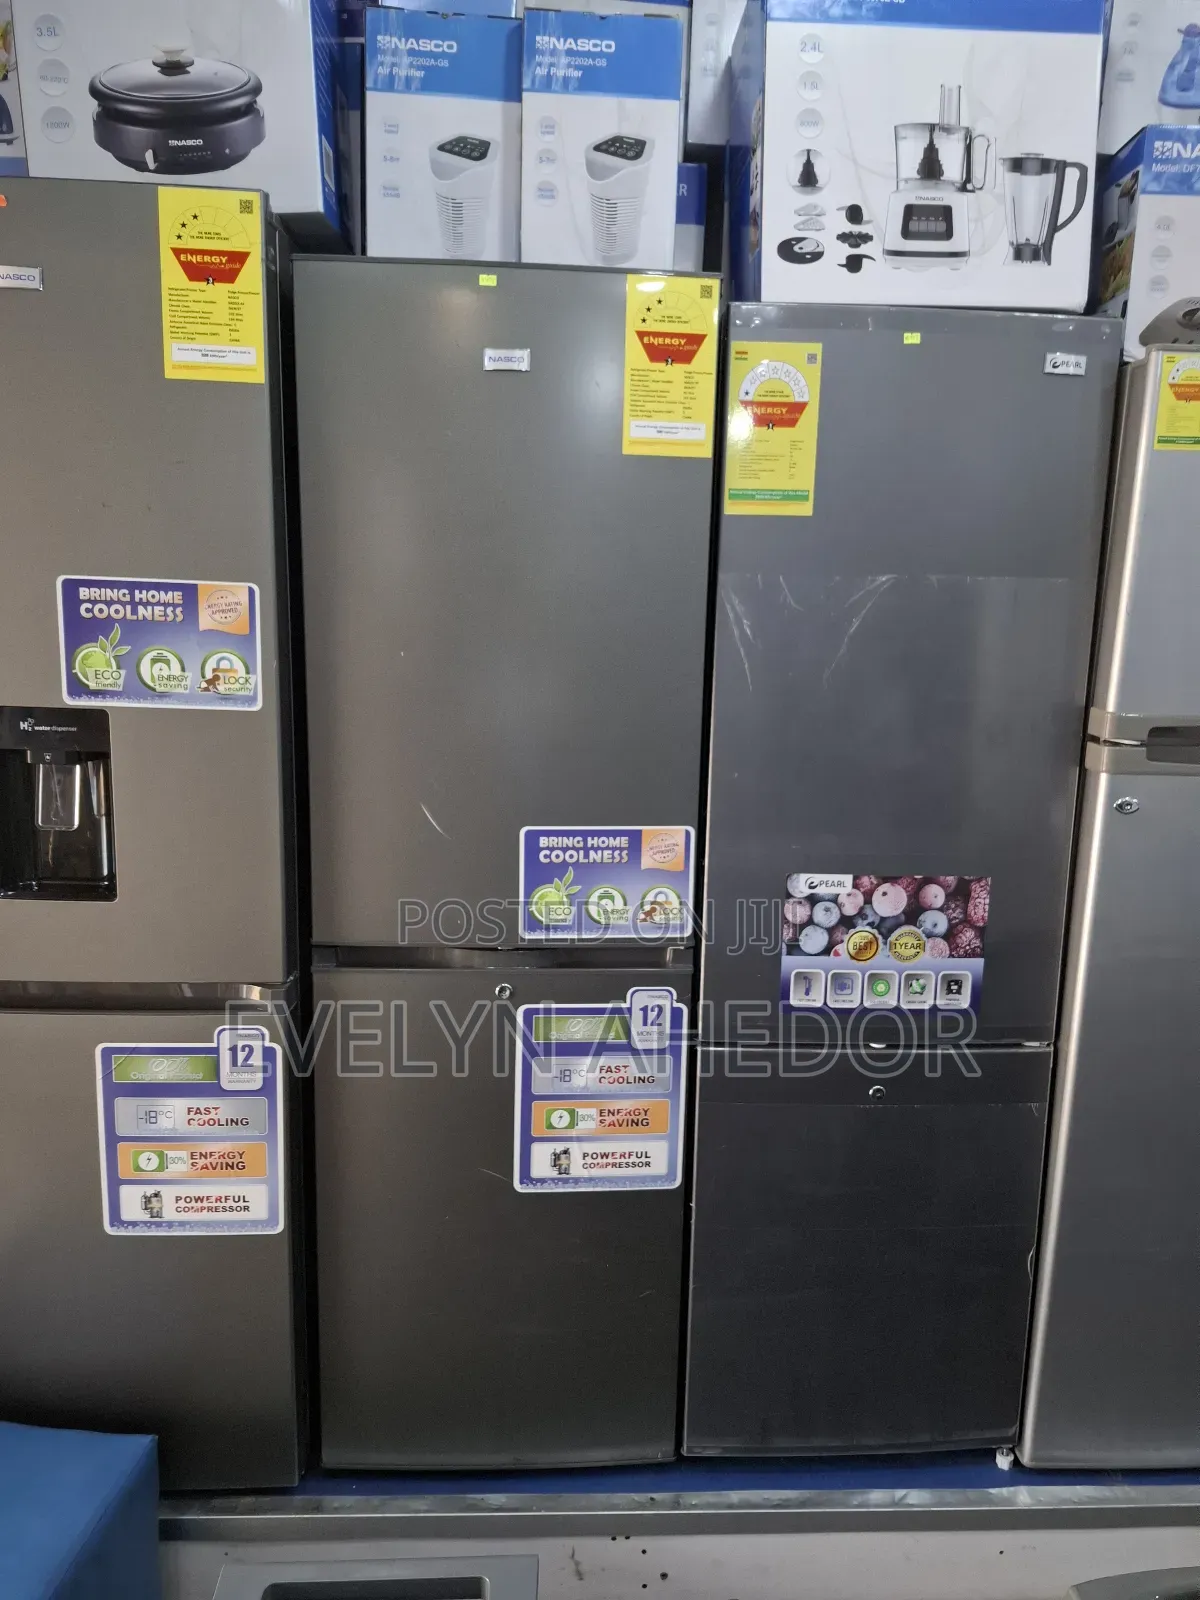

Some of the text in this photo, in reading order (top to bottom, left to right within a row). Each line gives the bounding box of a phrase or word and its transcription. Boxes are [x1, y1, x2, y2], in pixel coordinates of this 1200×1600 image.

[36, 27, 60, 37] 3.5L
[391, 37, 458, 53] NASCO
[549, 37, 616, 53] NASCO
[800, 41, 824, 53] 2.4L
[377, 66, 425, 78] Air Purifier
[535, 66, 584, 77] Air Purifier
[1152, 164, 1180, 173] Model:
[180, 253, 228, 264] ENERGY
[643, 336, 687, 346] ENERGY
[1061, 361, 1083, 369] PEARL
[746, 405, 788, 415] ENERGY
[79, 587, 184, 604] BRING HOME
[79, 602, 184, 622] COOLNESS
[94, 670, 122, 680] ECO
[157, 674, 189, 683] ENERGY
[95, 681, 122, 690] friendly
[223, 675, 252, 686] LOCK
[158, 683, 189, 691] saving
[223, 686, 253, 694] security
[539, 836, 629, 848] BRING HOME
[538, 850, 629, 864] COOLNESS
[819, 880, 847, 888] PEARL
[548, 907, 572, 916] ECO
[852, 941, 873, 951] BEST
[897, 942, 922, 950] YEAR
[639, 1004, 664, 1027] 12
[227, 1043, 255, 1068] 12
[599, 1065, 630, 1074] FAST
[598, 1075, 656, 1085] COOLING
[187, 1106, 221, 1116] FAST
[599, 1108, 651, 1118] ENERGY
[187, 1117, 250, 1127] COOLING
[579, 1114, 596, 1122] 30%
[599, 1118, 650, 1128] SAVING
[168, 1156, 186, 1165] 30%
[190, 1151, 246, 1161] ENERGY
[582, 1151, 652, 1161] POWERFUL
[190, 1161, 247, 1171] SAVING
[582, 1161, 652, 1170] COMPRESSOR
[175, 1195, 250, 1204] POWERFUL
[175, 1205, 250, 1213] COMPRESSOR
